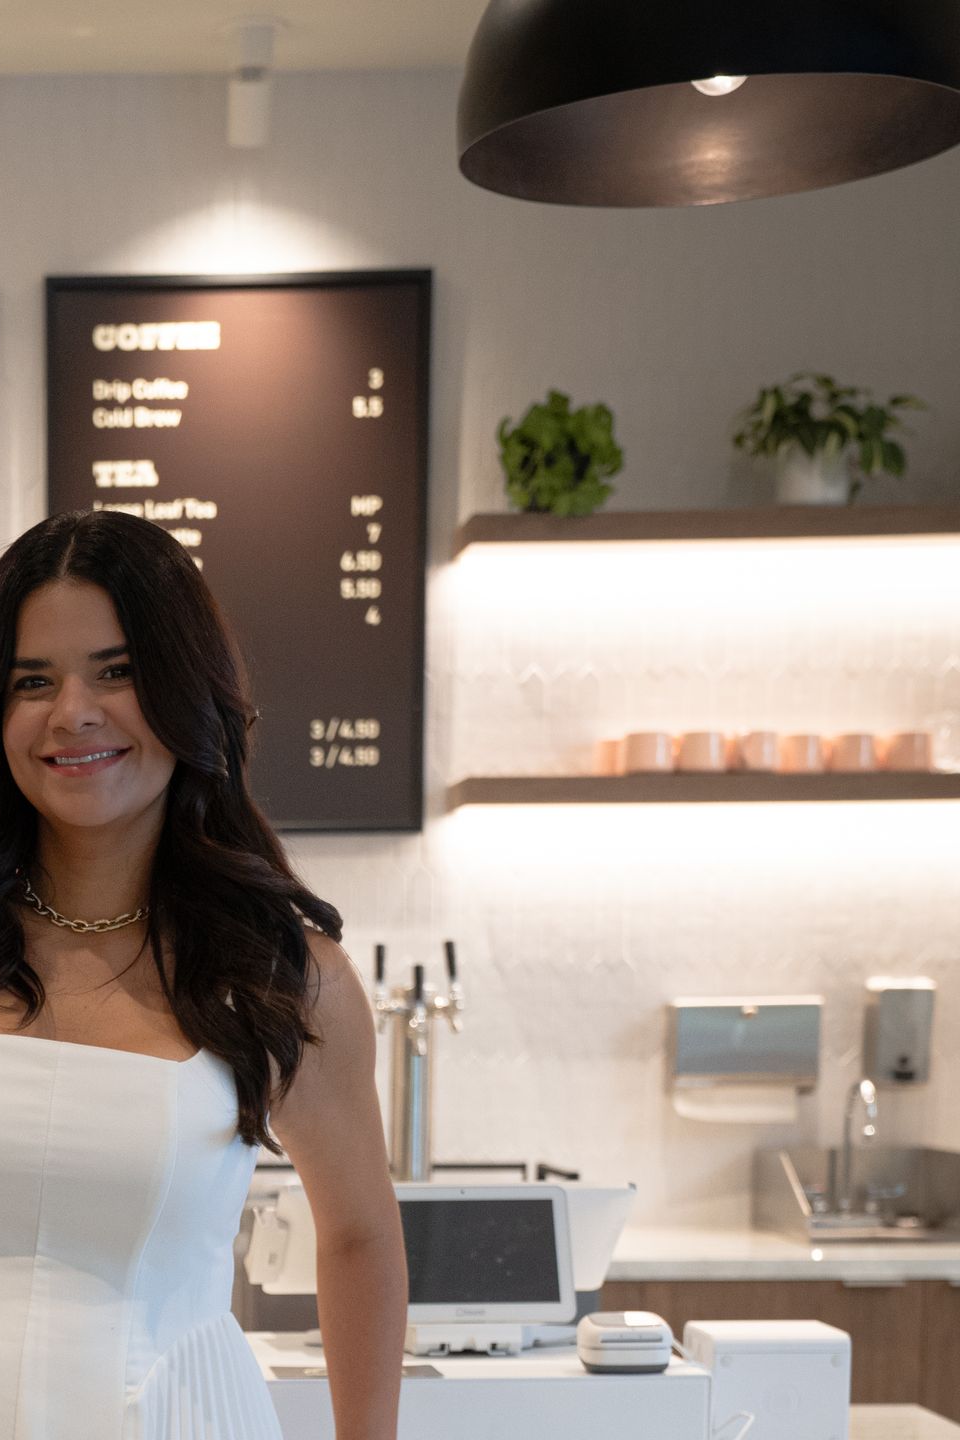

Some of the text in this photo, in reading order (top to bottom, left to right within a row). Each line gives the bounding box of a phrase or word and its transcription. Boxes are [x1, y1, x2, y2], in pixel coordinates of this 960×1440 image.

[93, 321, 220, 350] COFFEE
[369, 367, 383, 389] 3
[93, 459, 159, 487] TEA
